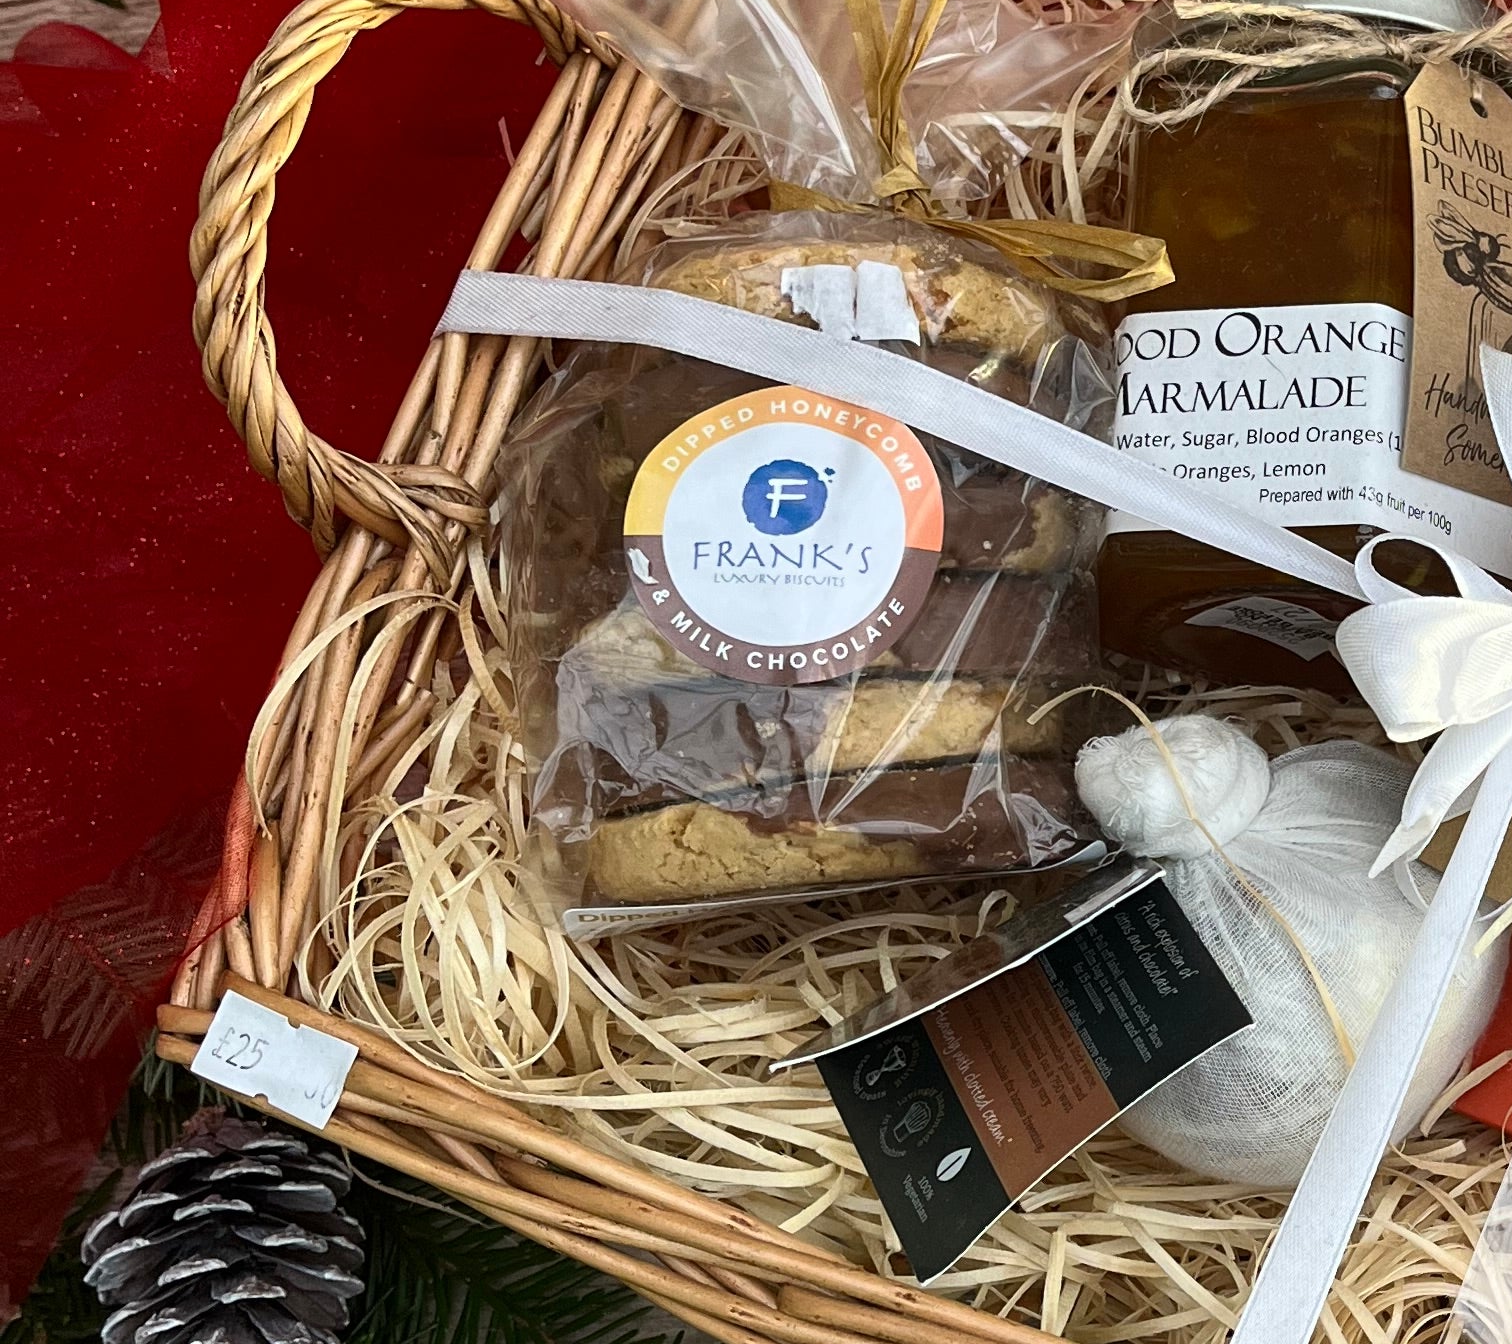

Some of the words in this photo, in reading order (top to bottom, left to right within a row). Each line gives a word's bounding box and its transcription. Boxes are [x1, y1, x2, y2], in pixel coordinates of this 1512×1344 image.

[1215, 312, 1406, 362] ORANGE
[662, 408, 753, 472] DIPPED
[770, 399, 922, 493] HONEYCOMB
[1117, 432, 1175, 450] Water,
[1182, 431, 1239, 450] Sugar,
[1247, 427, 1299, 445] Blood
[1306, 426, 1383, 445] Oranges
[1173, 464, 1255, 483] Oranges,
[1263, 462, 1326, 477] Lemon
[1259, 487, 1322, 505] Prepared
[1327, 486, 1353, 500] with
[1359, 486, 1383, 505] 43g
[1387, 493, 1405, 513] fruit
[1408, 505, 1425, 519] per
[1428, 510, 1452, 535] 100g
[693, 540, 872, 574] FRANK'S
[713, 573, 780, 586] LUXURY
[784, 574, 845, 587] BISCUITS
[651, 589, 670, 606] &
[671, 611, 734, 660] MILK
[746, 598, 905, 670] CHOCOLATE
[1143, 908, 1167, 931] rich
[1125, 930, 1149, 954] and
[1151, 925, 1188, 971] explosion
[1177, 962, 1199, 982] of
[1116, 978, 1138, 1006] remove
[1143, 1023, 1166, 1049] Place
[1122, 1019, 1140, 1038] and
[211, 1026, 270, 1070] £25
[1078, 1027, 1099, 1057] remove
[961, 1069, 995, 1109] clotted
[902, 1173, 929, 1223] Vegetarian
[914, 1174, 938, 1201] 100%
